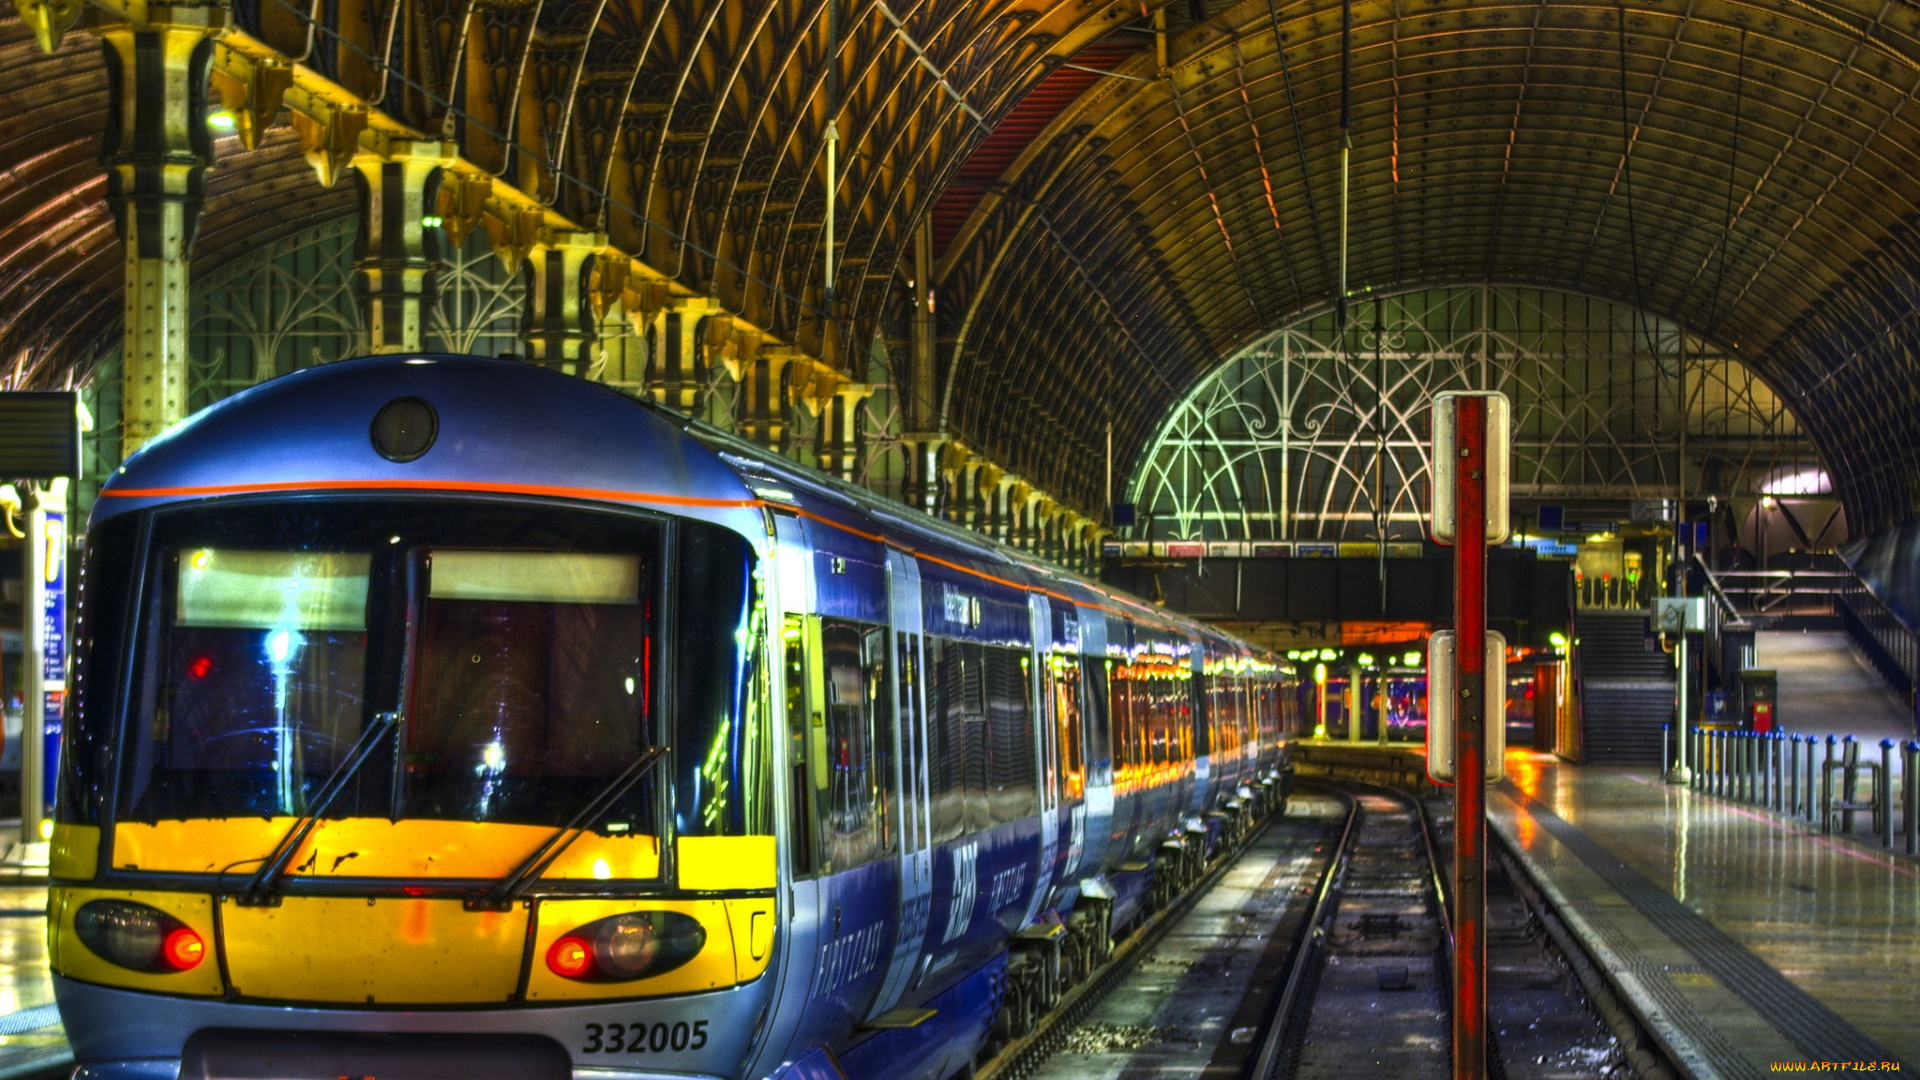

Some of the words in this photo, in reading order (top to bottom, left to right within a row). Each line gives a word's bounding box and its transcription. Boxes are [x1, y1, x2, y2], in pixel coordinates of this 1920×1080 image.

[813, 934, 854, 1002] FIRST
[848, 920, 883, 983] CLASS
[582, 1019, 709, 1054] 332005
